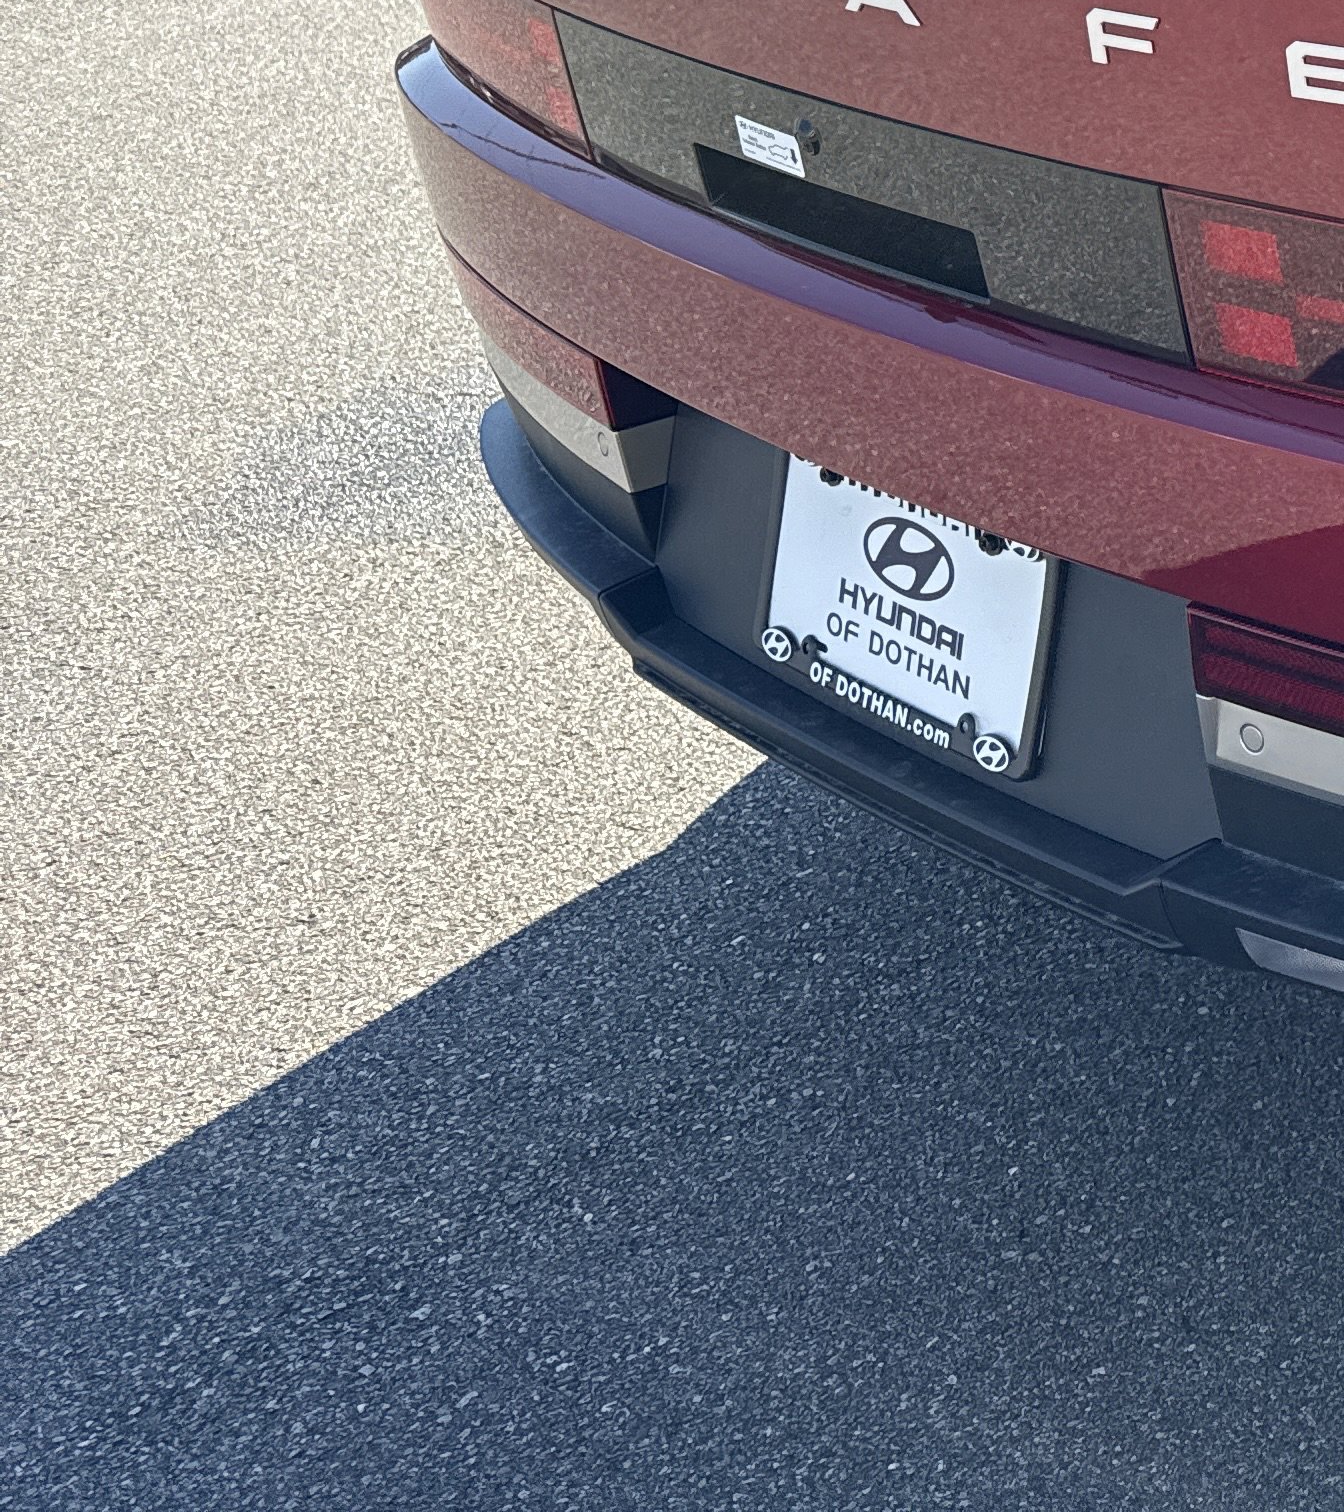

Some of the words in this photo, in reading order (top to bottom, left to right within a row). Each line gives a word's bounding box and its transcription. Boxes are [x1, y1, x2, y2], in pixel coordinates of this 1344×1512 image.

[826, 612, 859, 643] OF
[868, 630, 971, 701] DOTHAN
[838, 577, 964, 661] HYUNDAI
[809, 661, 833, 688] OF
[835, 675, 950, 749] DOTHAN.com
